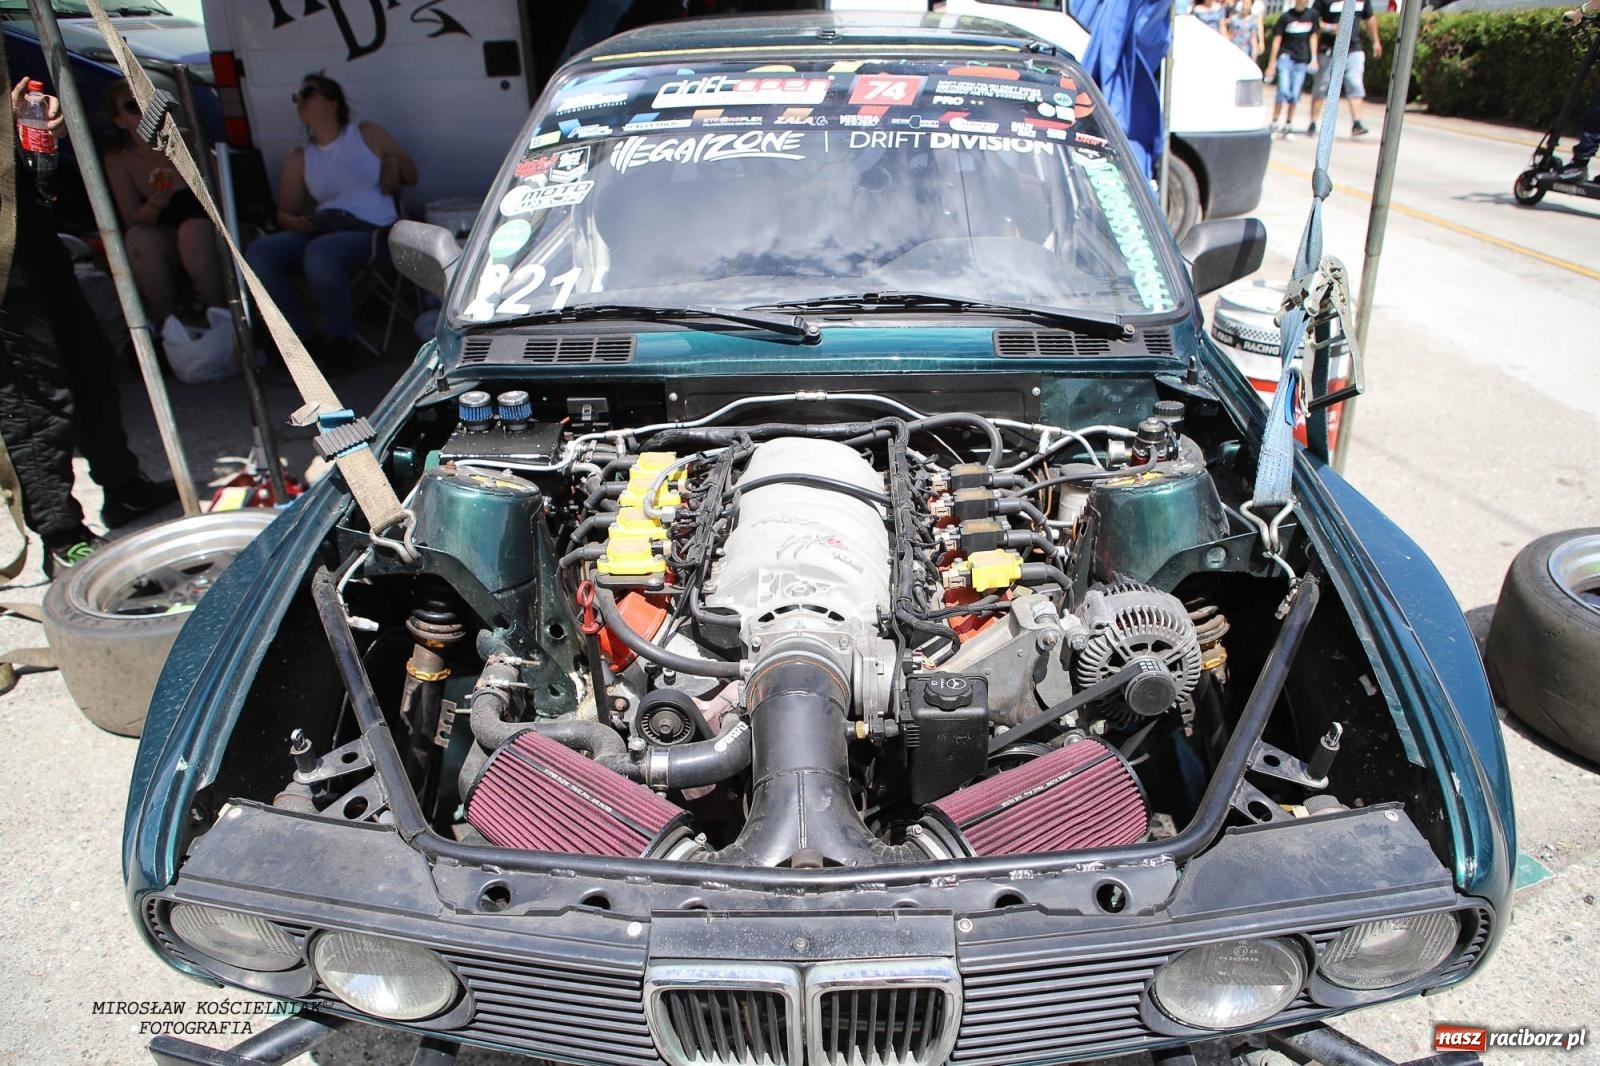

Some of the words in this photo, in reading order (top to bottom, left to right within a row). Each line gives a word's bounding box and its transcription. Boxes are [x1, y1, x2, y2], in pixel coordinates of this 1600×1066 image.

[864, 80, 907, 99] 74
[932, 95, 965, 105] PRO
[850, 131, 927, 149] DRIFT
[930, 132, 1054, 155] DIVISION
[1244, 342, 1281, 355] RACING
